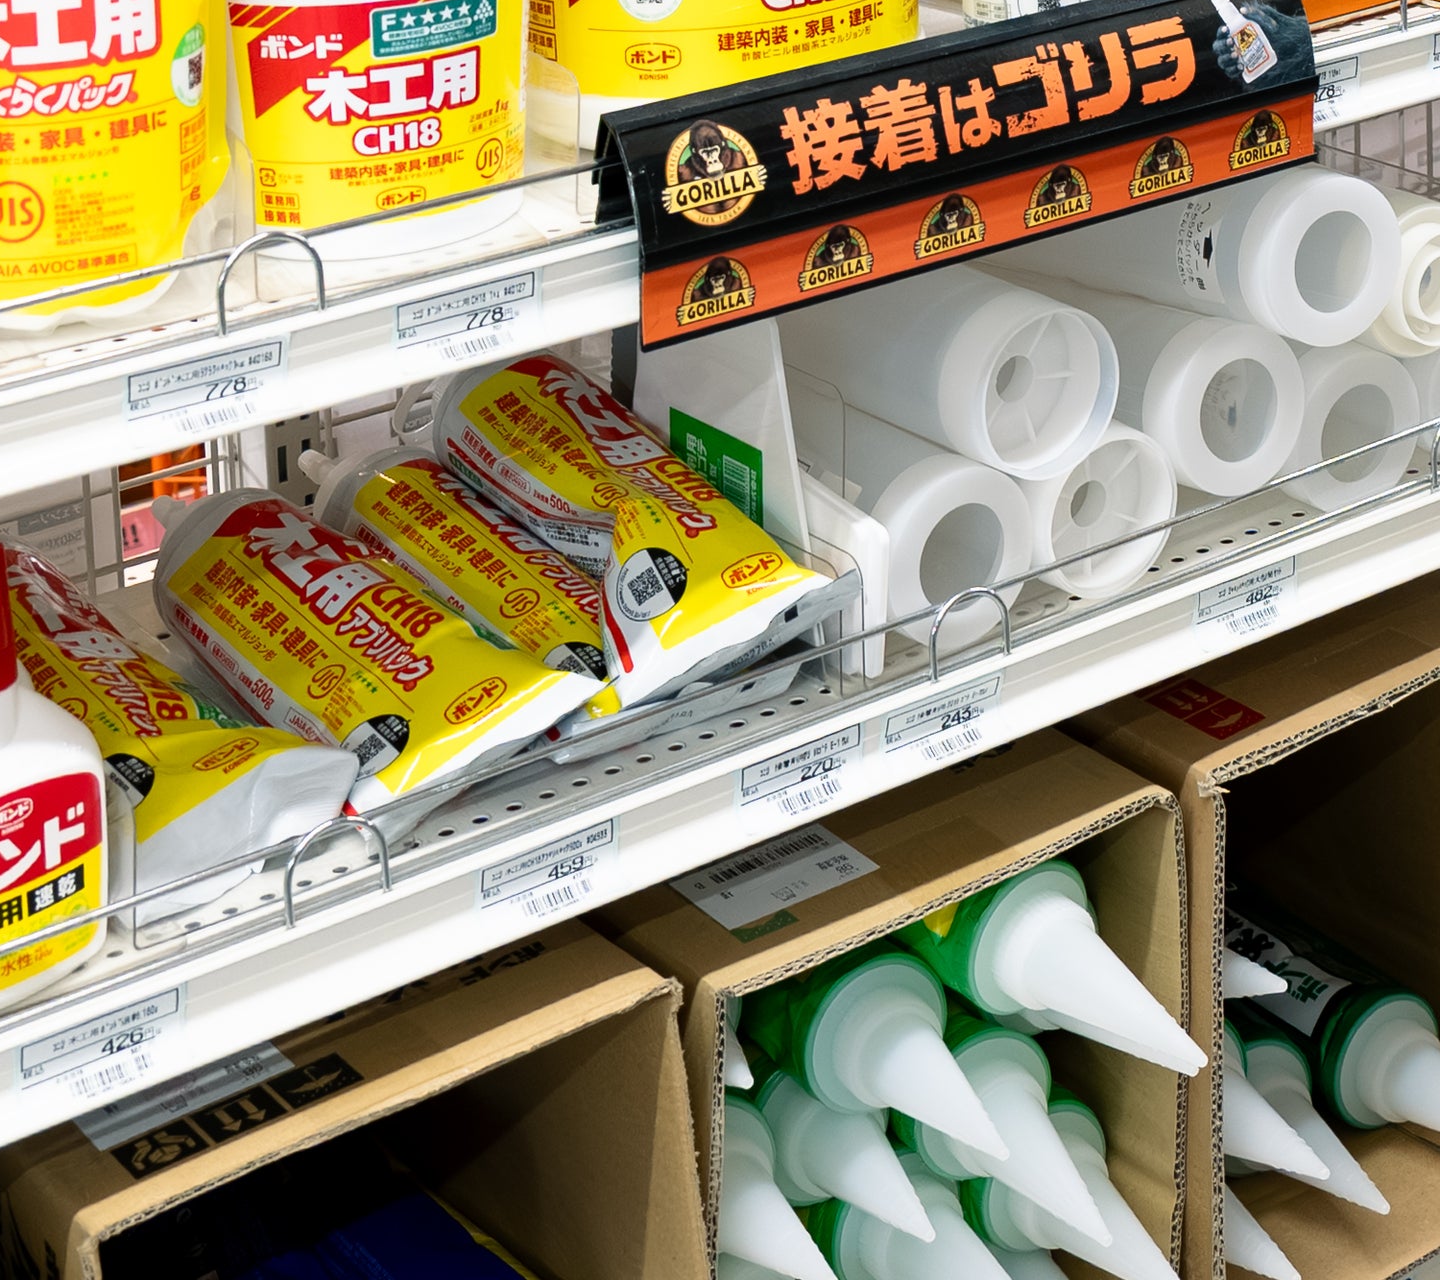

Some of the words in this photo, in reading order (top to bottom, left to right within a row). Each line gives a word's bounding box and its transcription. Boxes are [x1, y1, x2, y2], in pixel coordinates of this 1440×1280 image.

[259, 33, 343, 61] ボンド
[716, 0, 885, 54] 建築内装・家具・建具に
[305, 50, 480, 123] 木工用
[352, 117, 442, 157] CH18
[666, 157, 766, 213] GORILLA
[781, 23, 1199, 196] 接着はゴリラ
[372, 582, 441, 642] CH18
